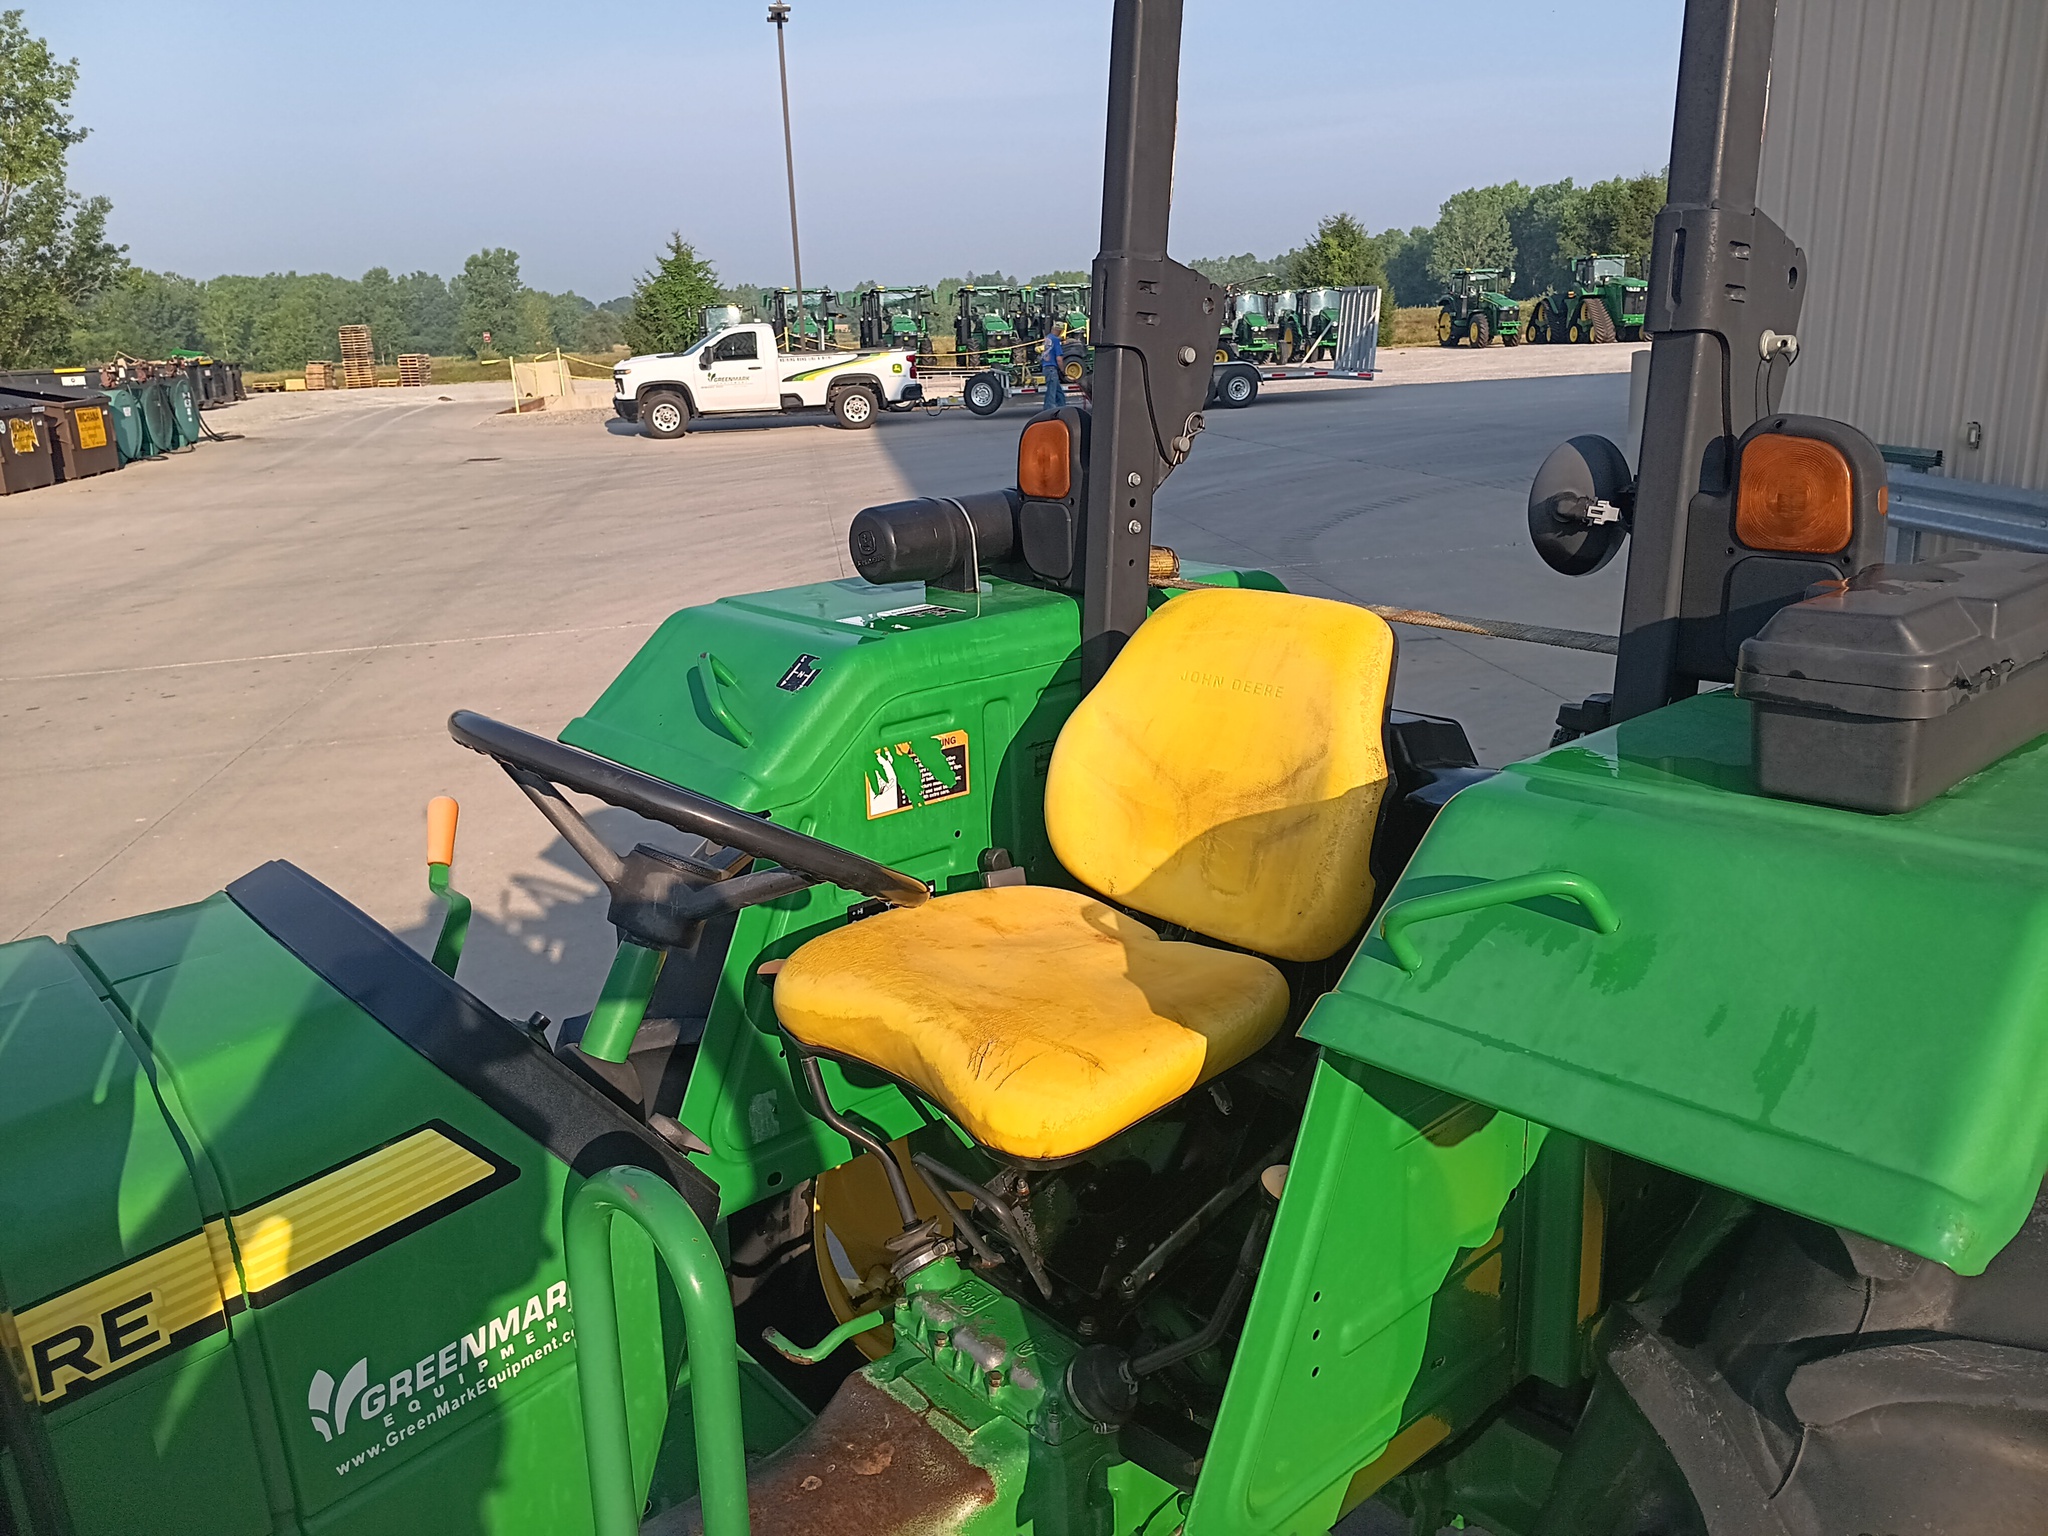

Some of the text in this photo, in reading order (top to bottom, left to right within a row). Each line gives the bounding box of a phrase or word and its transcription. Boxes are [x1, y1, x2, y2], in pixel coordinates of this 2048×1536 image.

[1179, 670, 1285, 699] JOHN DEERE
[336, 1329, 574, 1476] www.GreenMarkEquipment.c
[360, 1280, 571, 1421] GREENMAR
[383, 1318, 558, 1428] EQUIPMEN
